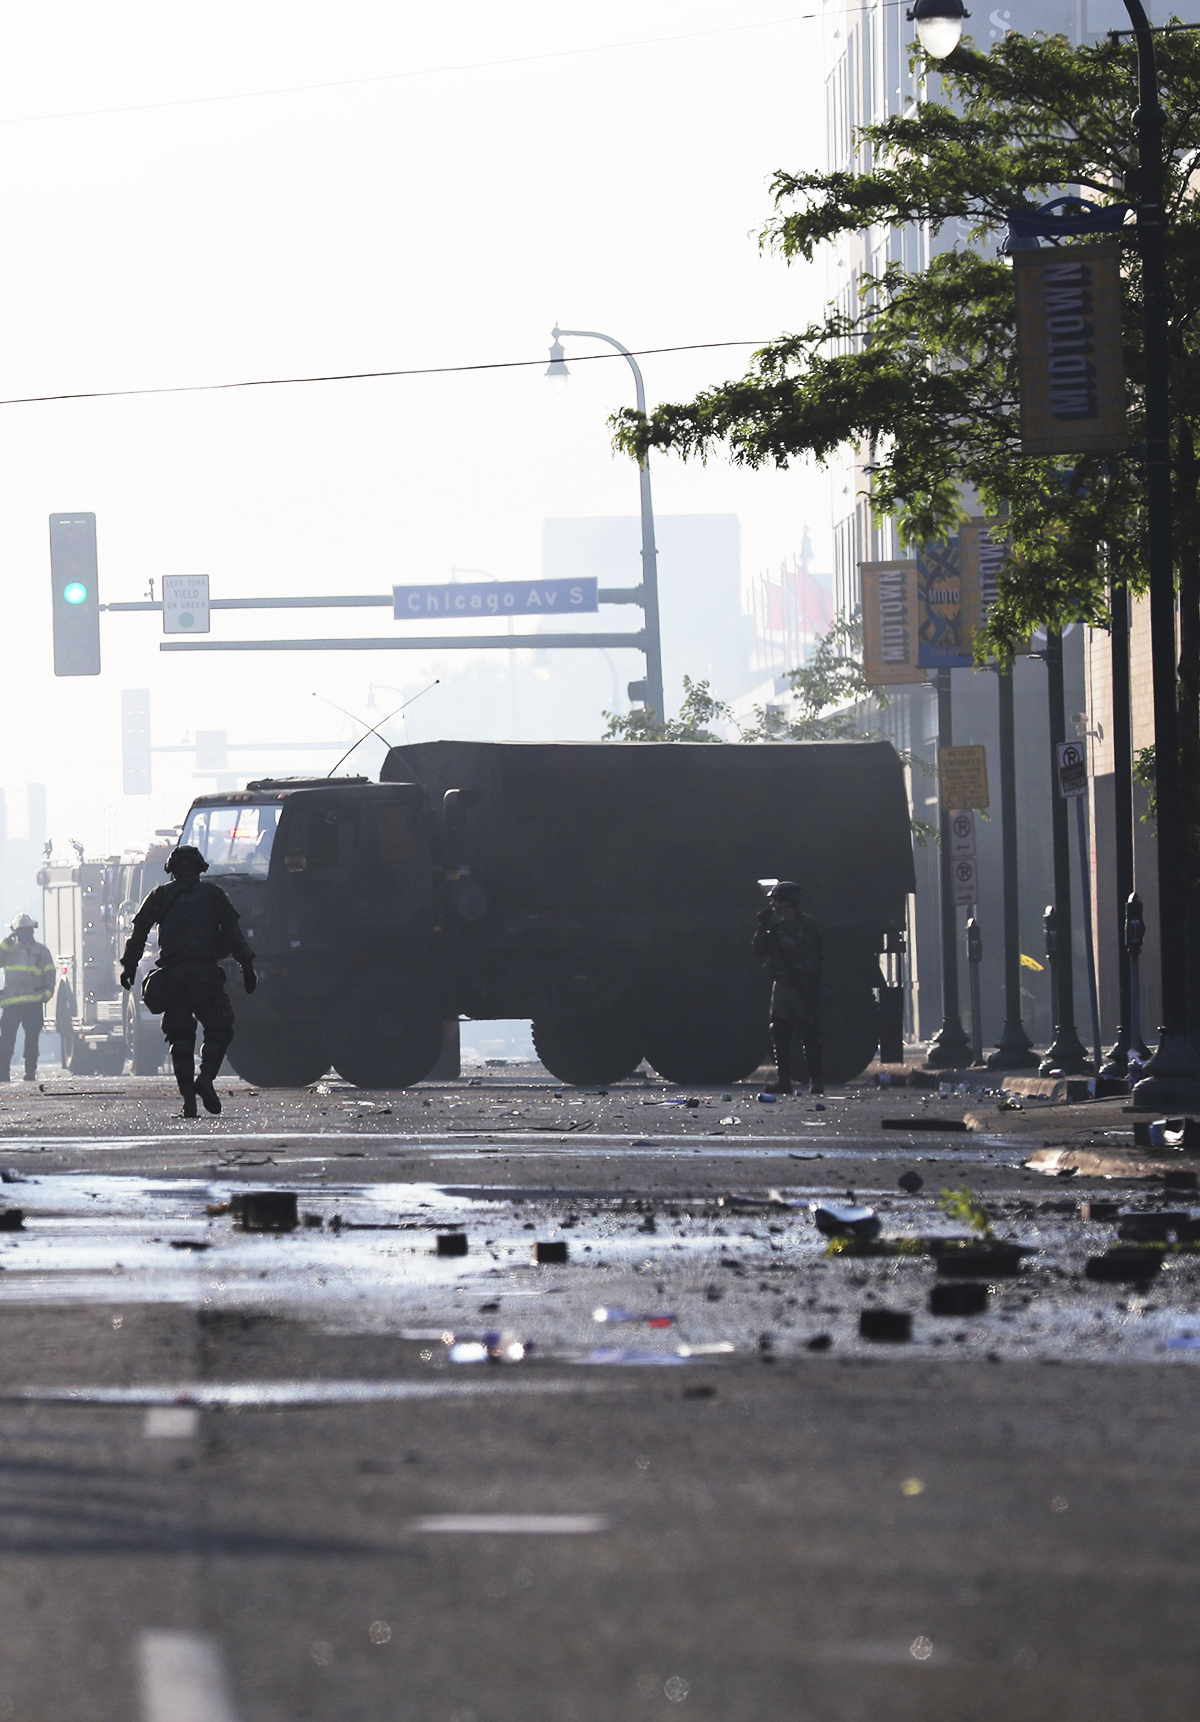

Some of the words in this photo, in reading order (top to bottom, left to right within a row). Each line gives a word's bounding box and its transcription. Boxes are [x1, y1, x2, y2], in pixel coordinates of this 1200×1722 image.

[1044, 261, 1090, 416] MIDTOWN
[174, 589, 199, 599] YIELD
[407, 591, 515, 613] Chicago
[526, 588, 558, 607] Av
[570, 586, 584, 605] S
[928, 589, 960, 603] MIDTO
[181, 601, 206, 609] GREEN
[878, 570, 905, 662] MIDTOWN
